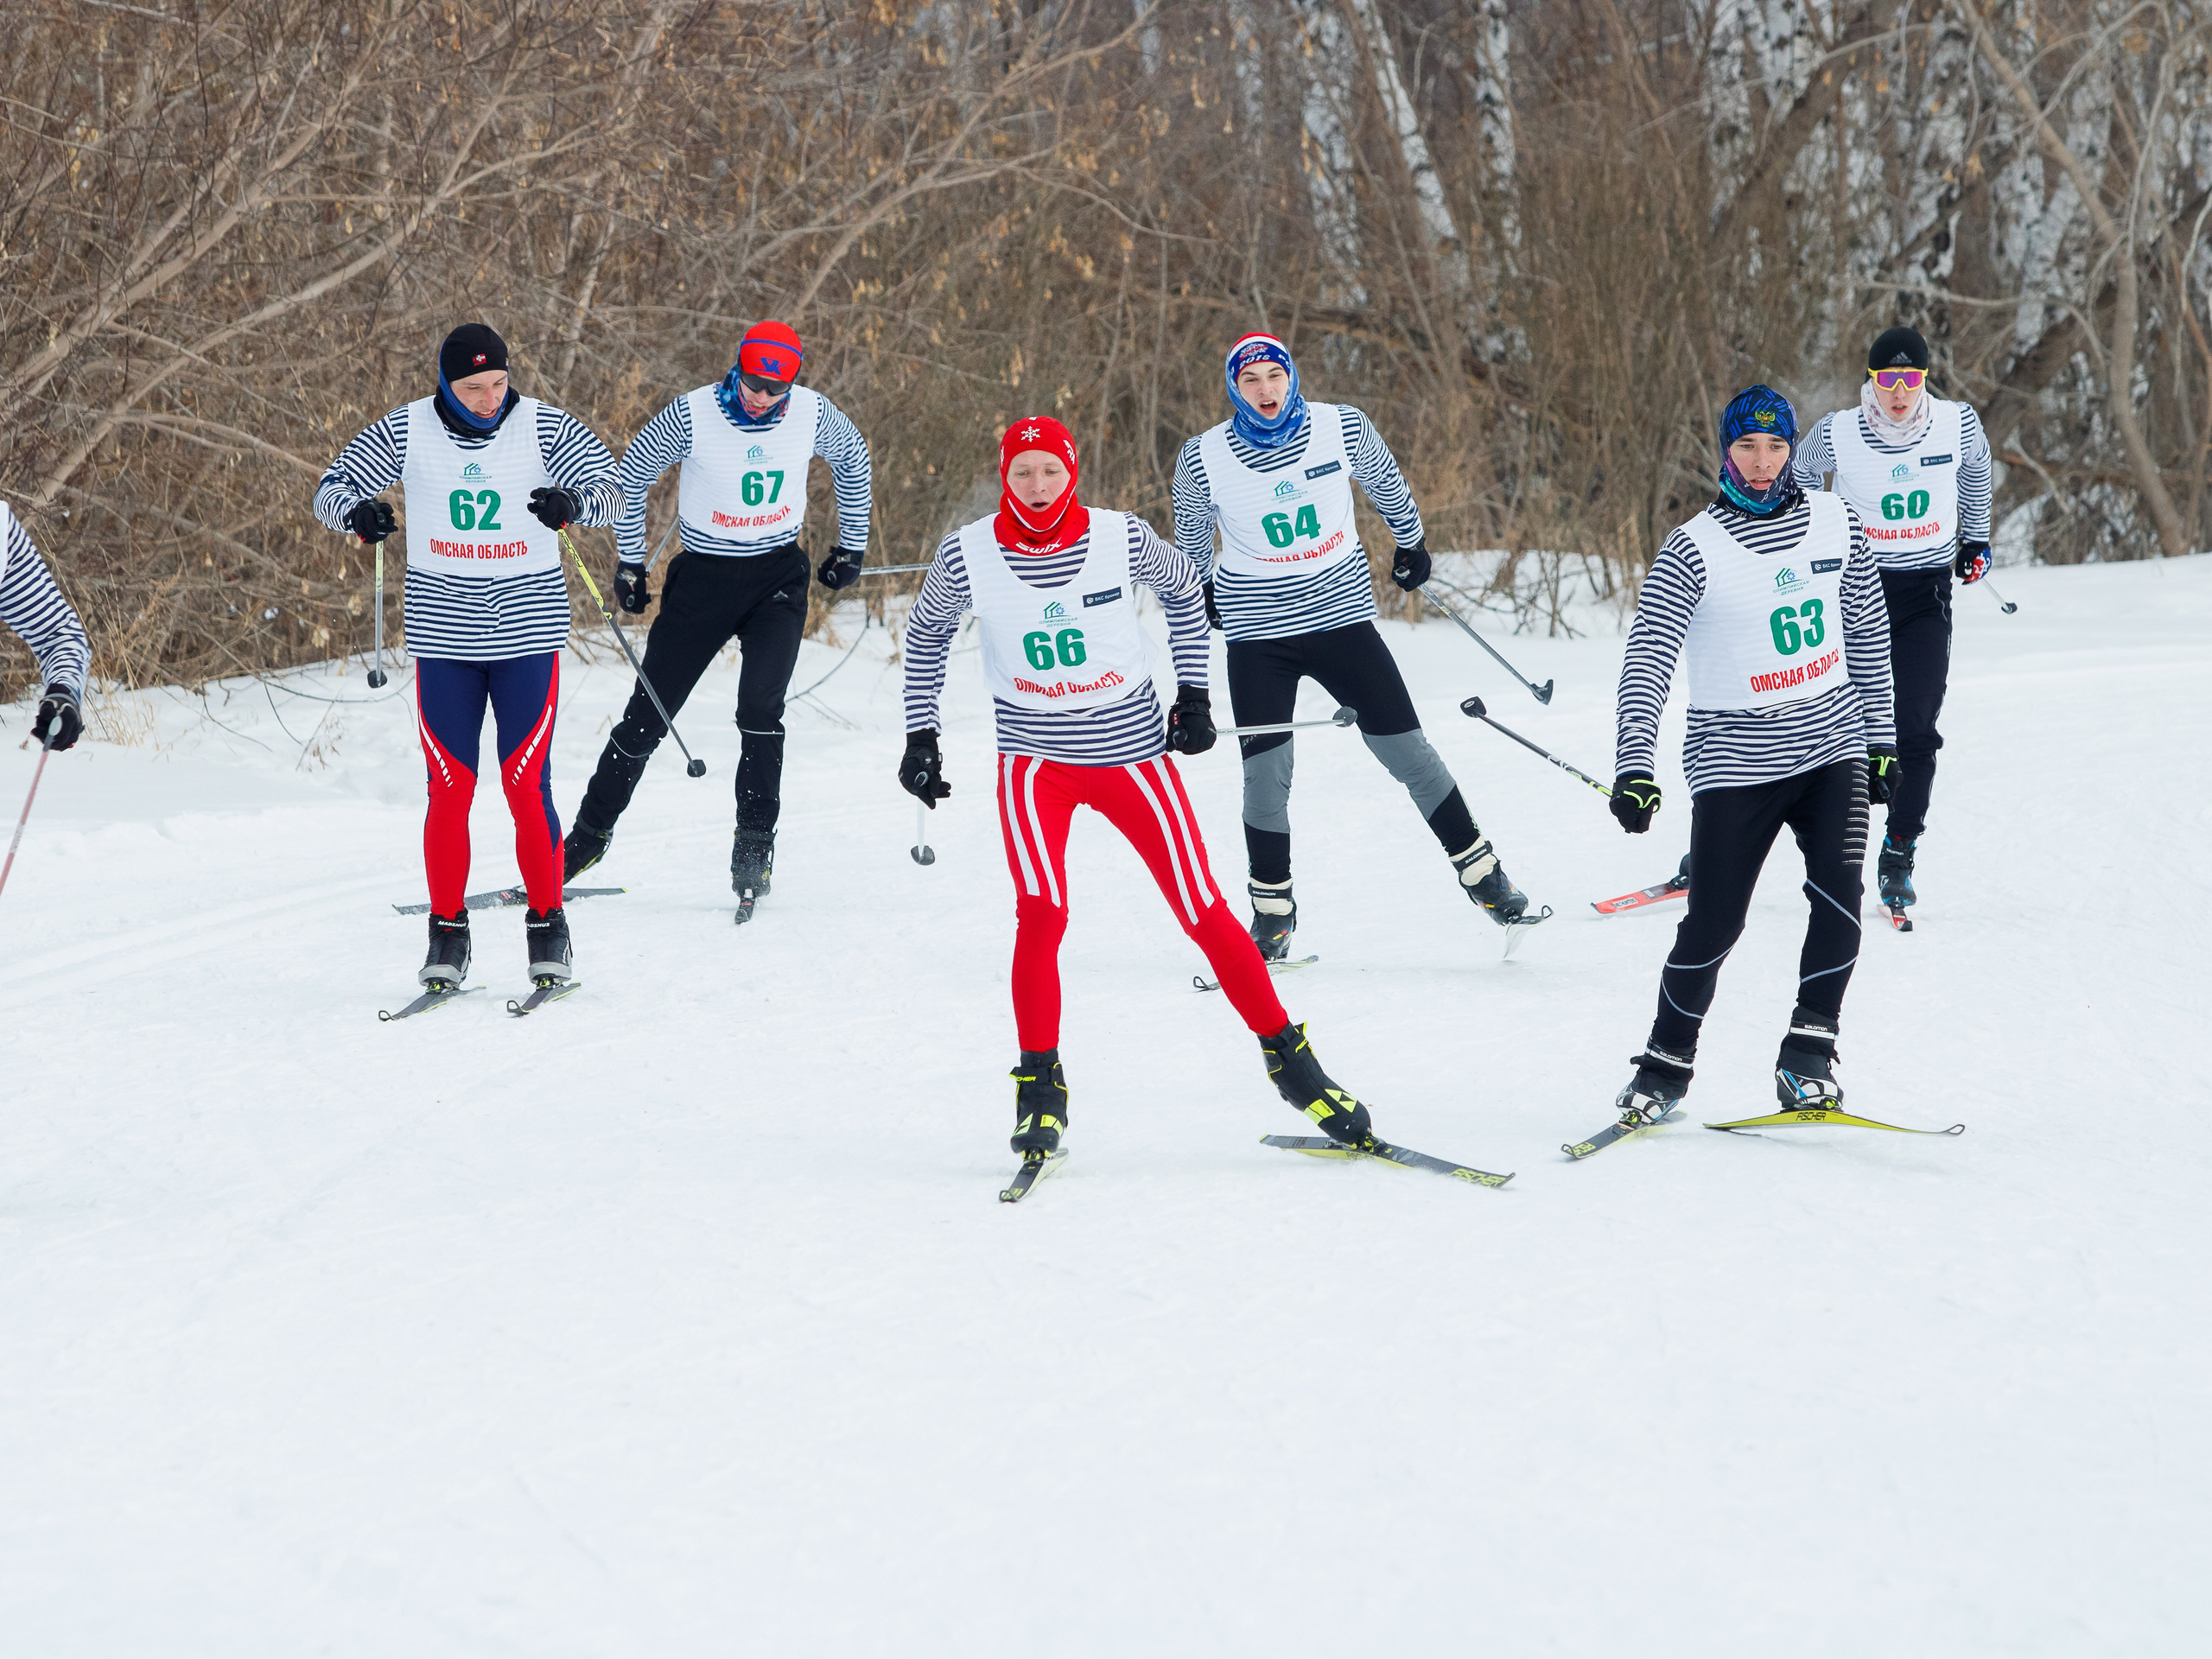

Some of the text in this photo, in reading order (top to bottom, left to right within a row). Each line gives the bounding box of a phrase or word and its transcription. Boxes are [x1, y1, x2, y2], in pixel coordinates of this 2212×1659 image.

[741, 470, 785, 506] 67
[449, 489, 501, 531] 62
[1881, 490, 1930, 520] 60
[712, 511, 750, 527] ОМСКАЯ
[1262, 504, 1321, 548] 64
[1864, 526, 1897, 540] МСКАЯ
[430, 538, 528, 559] ОМСКАЯ ОБЛАСТЬ
[1770, 598, 1826, 656] 63
[1023, 628, 1087, 671] 66
[1751, 666, 1805, 693] ОМСКАЯ
[1465, 848, 1487, 864] SALOMON
[1295, 1038, 1308, 1053] FISC
[1796, 1111, 1827, 1122] FISCHER
[1450, 1167, 1505, 1188] FISCHER
